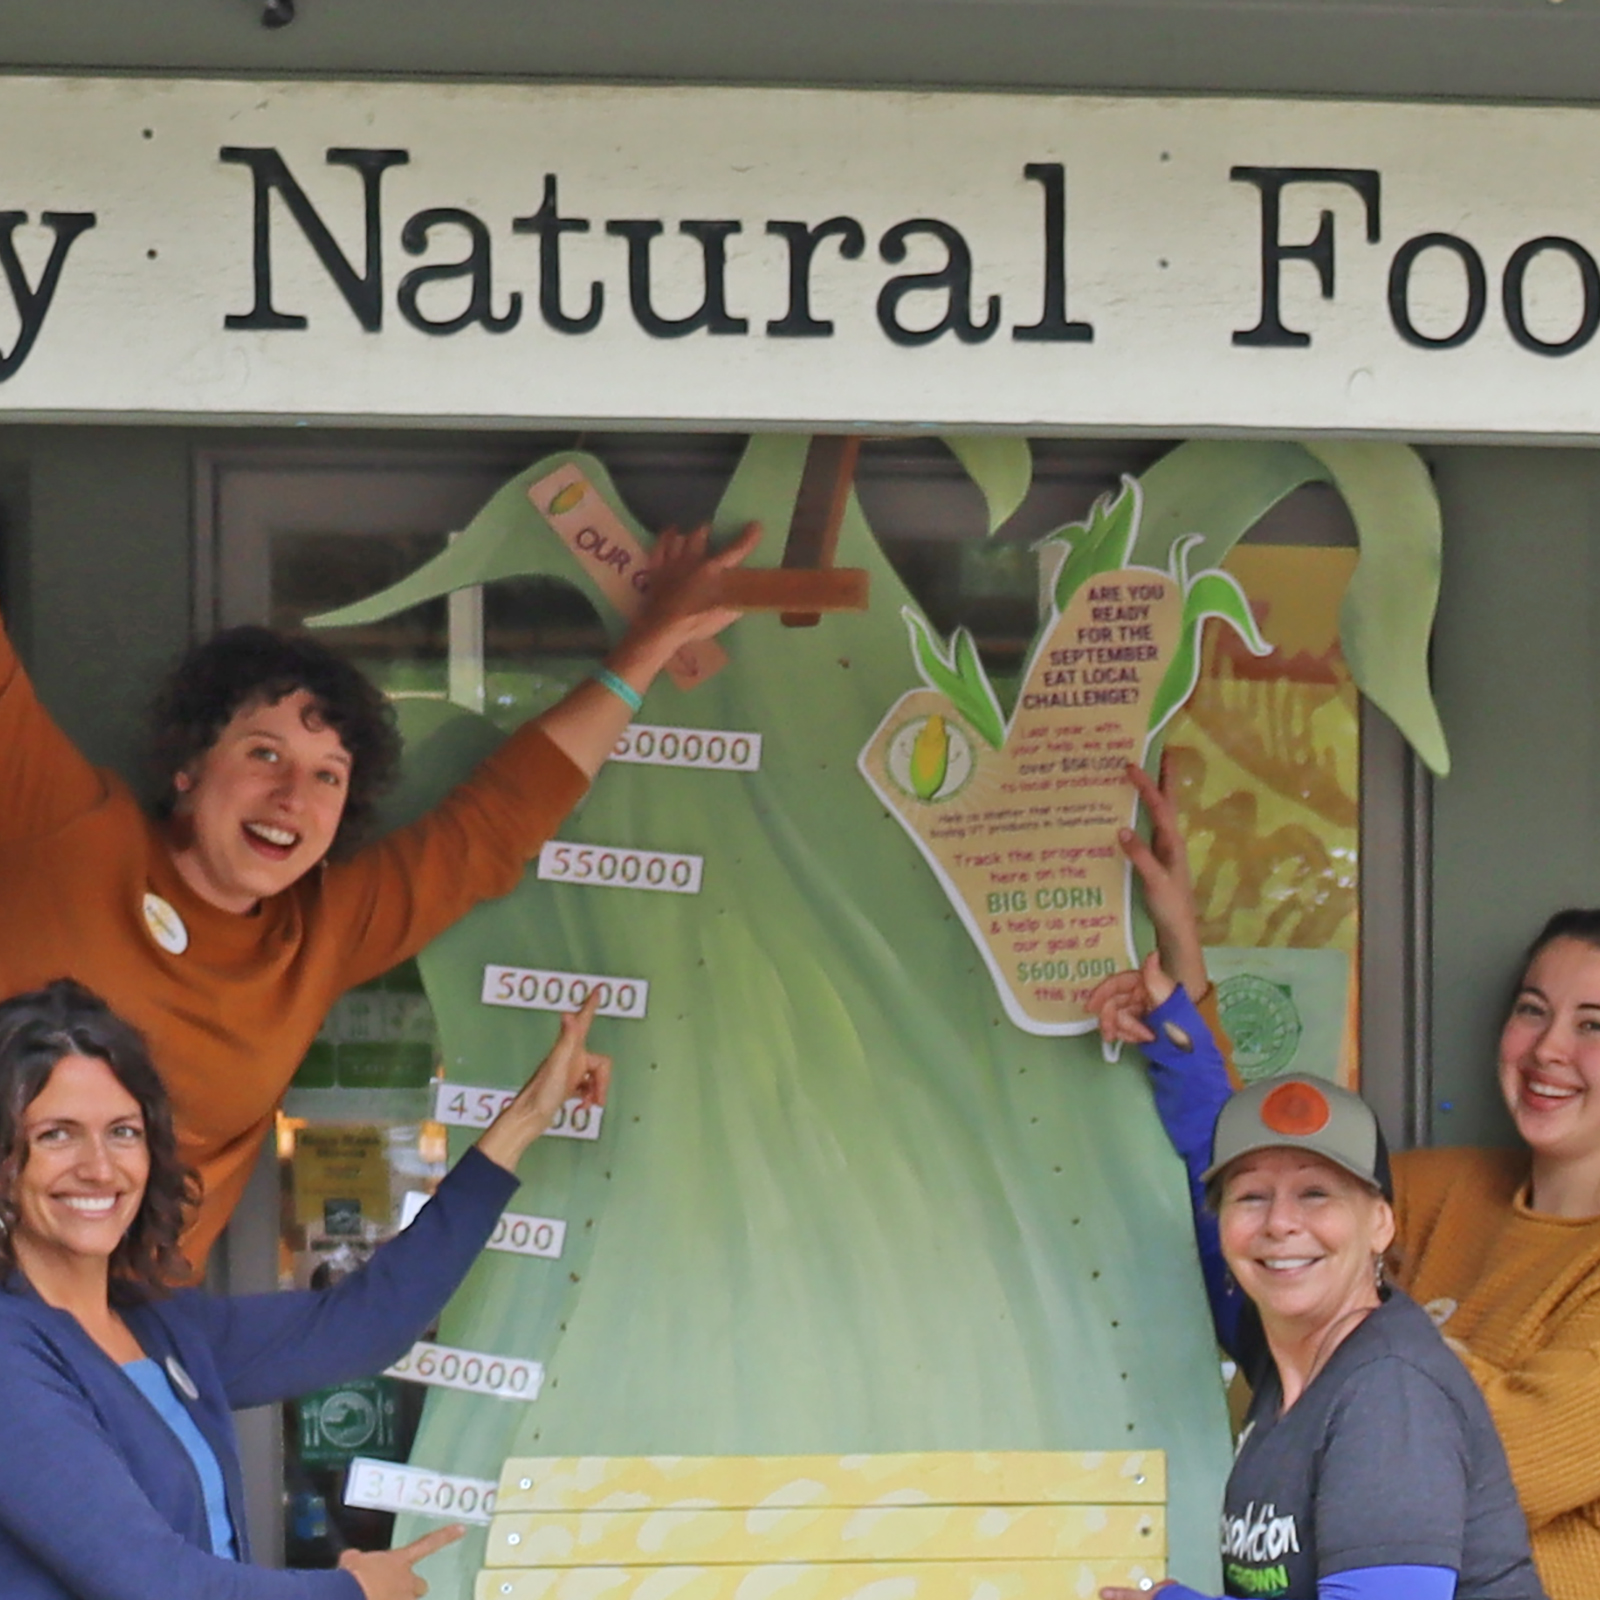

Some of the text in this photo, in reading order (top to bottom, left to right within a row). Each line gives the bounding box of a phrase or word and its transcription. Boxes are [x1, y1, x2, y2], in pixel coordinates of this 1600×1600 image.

[220, 147, 1093, 345] Natural
[576, 528, 631, 574] OUR
[1088, 585, 1164, 601] ARE YOU
[1092, 605, 1149, 621] READY
[1078, 625, 1153, 643] FOR THE
[1050, 646, 1158, 665] SEPTEMBER
[1044, 667, 1139, 687] EAT LOCAL
[1023, 688, 1139, 709] CHALLENGE?
[550, 846, 694, 888] 550000
[987, 887, 1104, 914] BIG CORN
[1017, 957, 1117, 983] $600,000
[496, 971, 638, 1013] 500000
